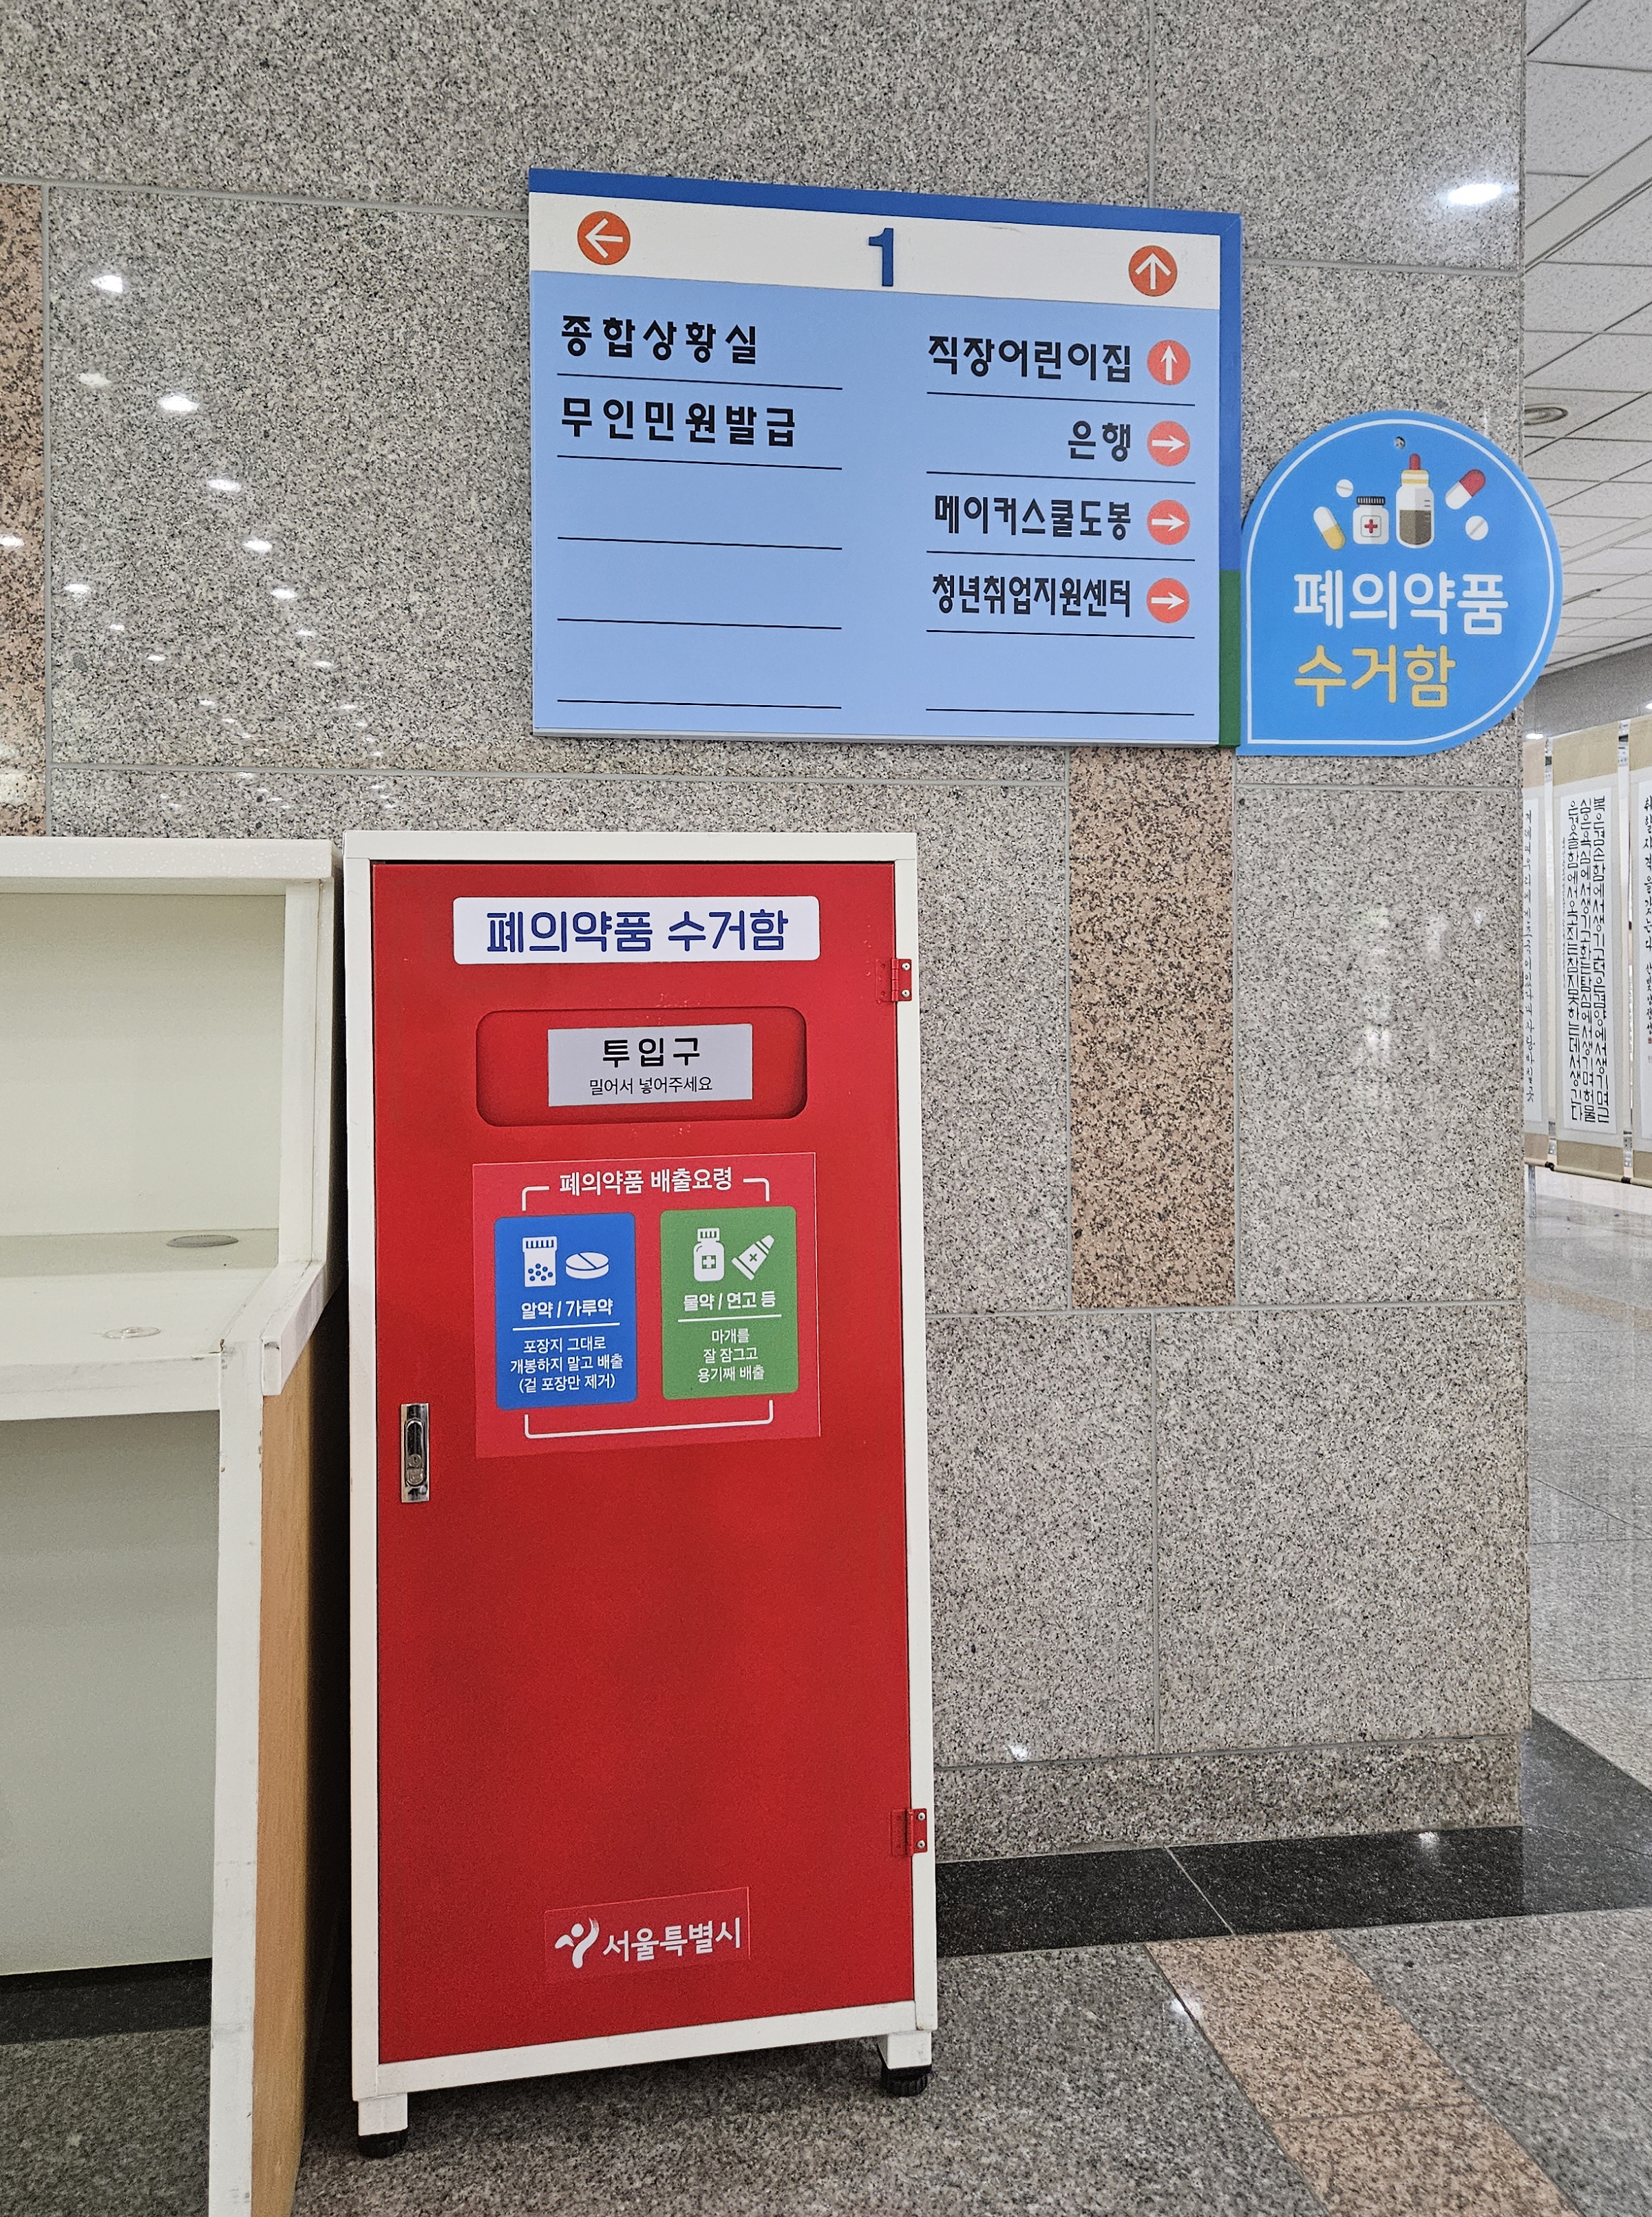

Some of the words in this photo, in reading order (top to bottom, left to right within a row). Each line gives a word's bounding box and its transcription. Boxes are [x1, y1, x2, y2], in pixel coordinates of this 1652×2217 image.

[868, 227, 894, 287] 1
[561, 315, 756, 365] 종합상황실
[928, 335, 1130, 383] 직장어린이집
[561, 397, 796, 448] 무인민원발급
[1068, 420, 1131, 462] 은행
[935, 495, 1131, 541] 메이커스쿨도봉
[932, 574, 1130, 618] 청년취업지원센터
[1293, 569, 1509, 635] 폐의약품
[1294, 644, 1456, 708] 수거함
[487, 911, 653, 953] 폐의약품
[668, 908, 789, 952] 수거함
[602, 1037, 700, 1069] 투입구
[590, 1078, 633, 1096] 밀어서
[639, 1075, 713, 1095] 넣어주세요
[559, 1170, 644, 1197] 폐의약품
[650, 1166, 732, 1193] 배출요령
[521, 1301, 553, 1320] 알약
[565, 1298, 613, 1317] 가루약
[683, 1293, 715, 1312] 물약
[726, 1292, 757, 1310] 연고
[761, 1290, 776, 1307] 등
[523, 1337, 562, 1354] 포장지
[566, 1336, 606, 1352] 그대로
[711, 1327, 750, 1345] 마개를
[510, 1356, 562, 1374] 개봉하지
[567, 1355, 594, 1372] 말고
[597, 1353, 624, 1369] 배출
[697, 1365, 736, 1383] 용기째
[739, 1364, 765, 1381] 배출
[703, 1347, 717, 1364] 잘
[719, 1347, 759, 1363] 잠그고
[519, 1377, 537, 1394] (겉
[541, 1374, 581, 1391] 포장만
[584, 1373, 615, 1389] 제거)
[602, 1917, 741, 1962] 서울특별시
